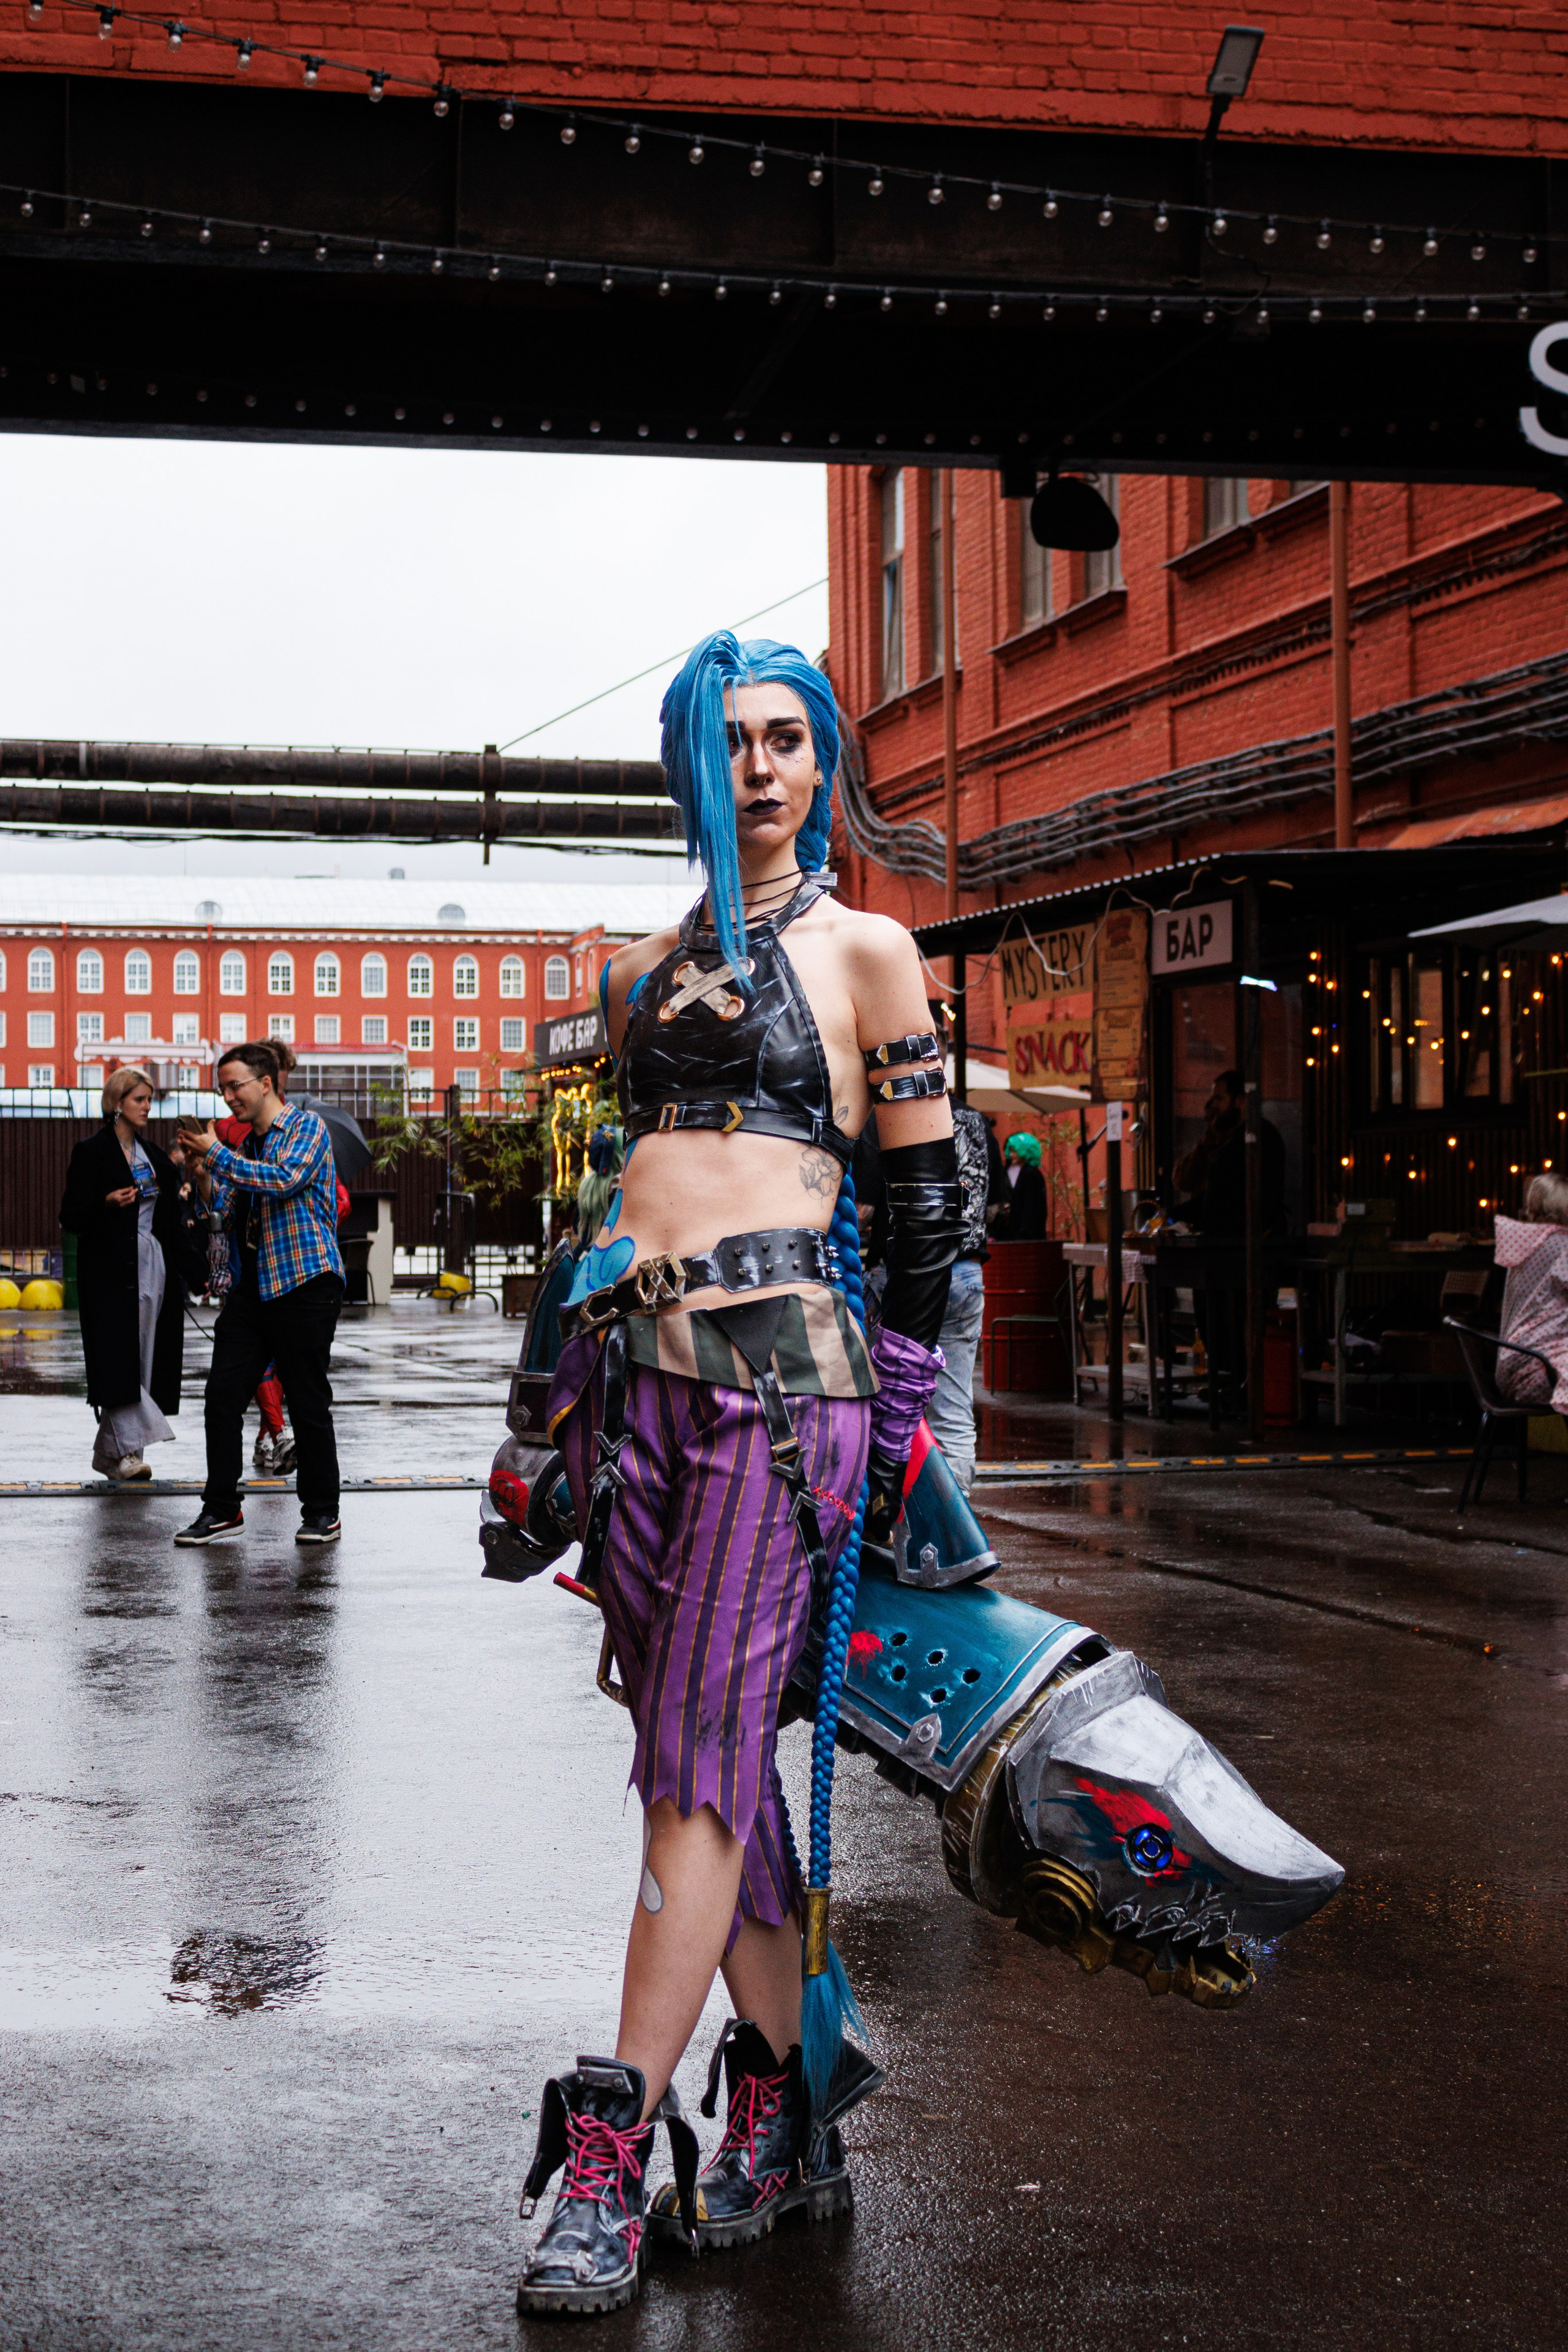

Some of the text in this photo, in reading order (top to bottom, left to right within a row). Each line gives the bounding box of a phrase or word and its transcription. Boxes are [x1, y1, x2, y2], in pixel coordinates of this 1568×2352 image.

[1166, 913, 1213, 963] БАР
[1001, 931, 1085, 1000] MYSTERY
[549, 1020, 575, 1056] КОФЕ
[575, 1015, 598, 1050] БАР
[1014, 1030, 1091, 1076] SNACK
